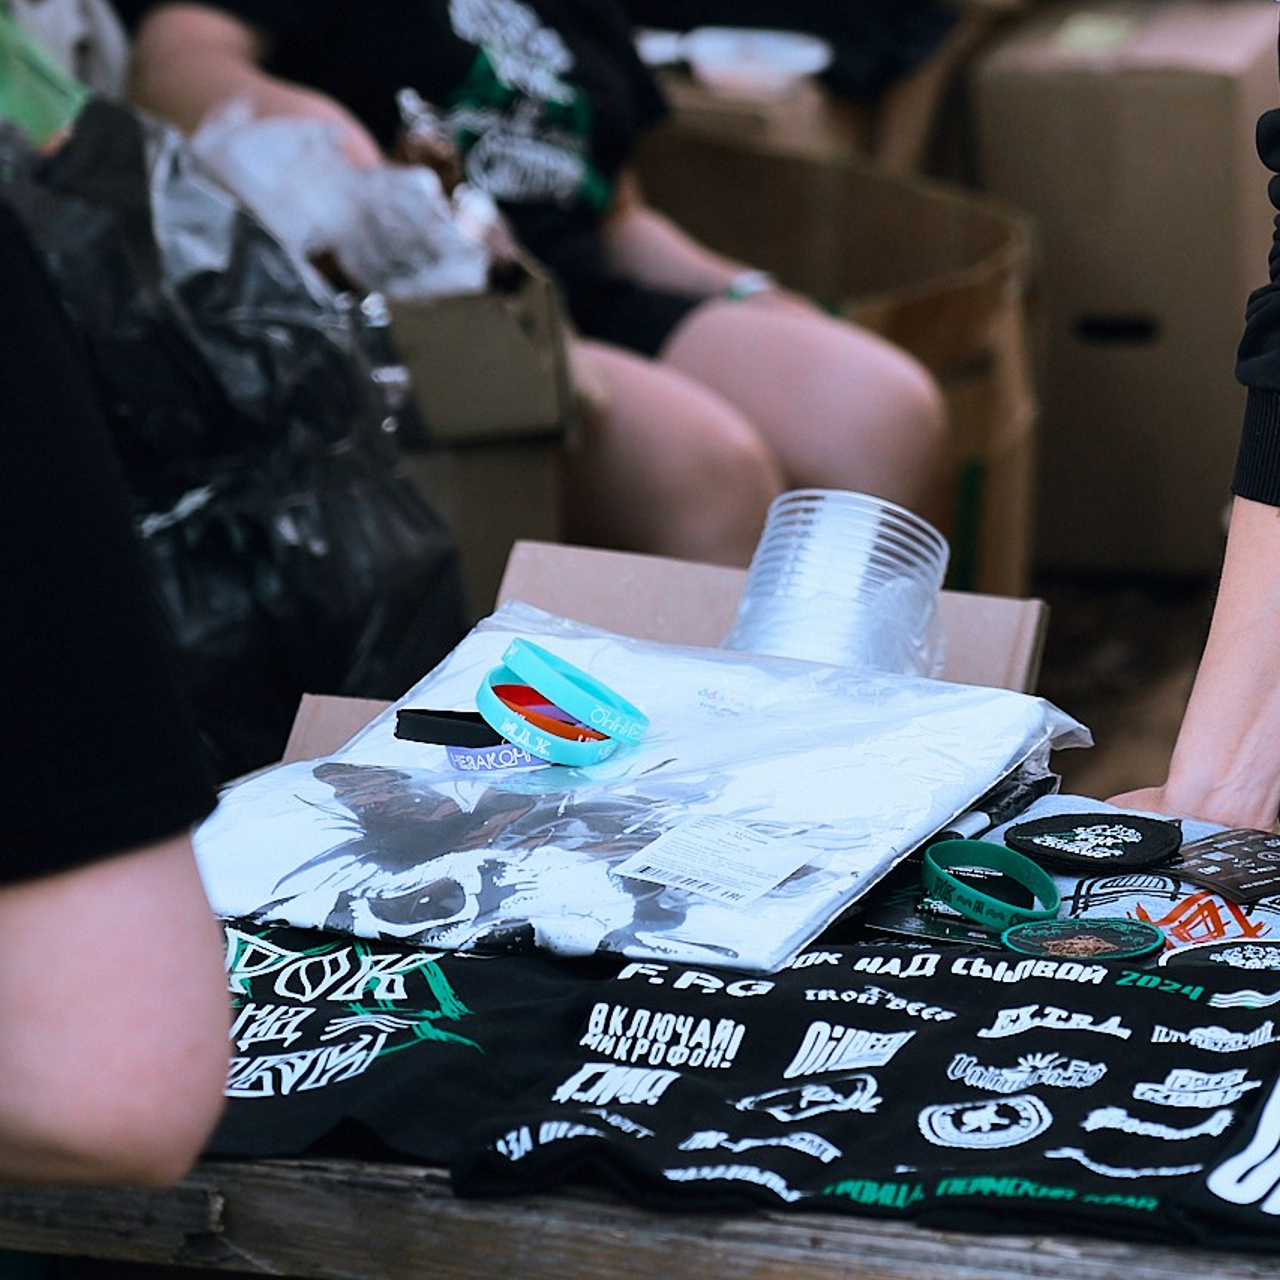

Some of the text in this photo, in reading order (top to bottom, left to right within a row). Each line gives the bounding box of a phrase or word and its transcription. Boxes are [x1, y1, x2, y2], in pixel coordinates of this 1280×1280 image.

[853, 953, 941, 979] НАД
[951, 957, 1108, 985] СЫЛВОЙ
[1116, 970, 1204, 1002] 2024
